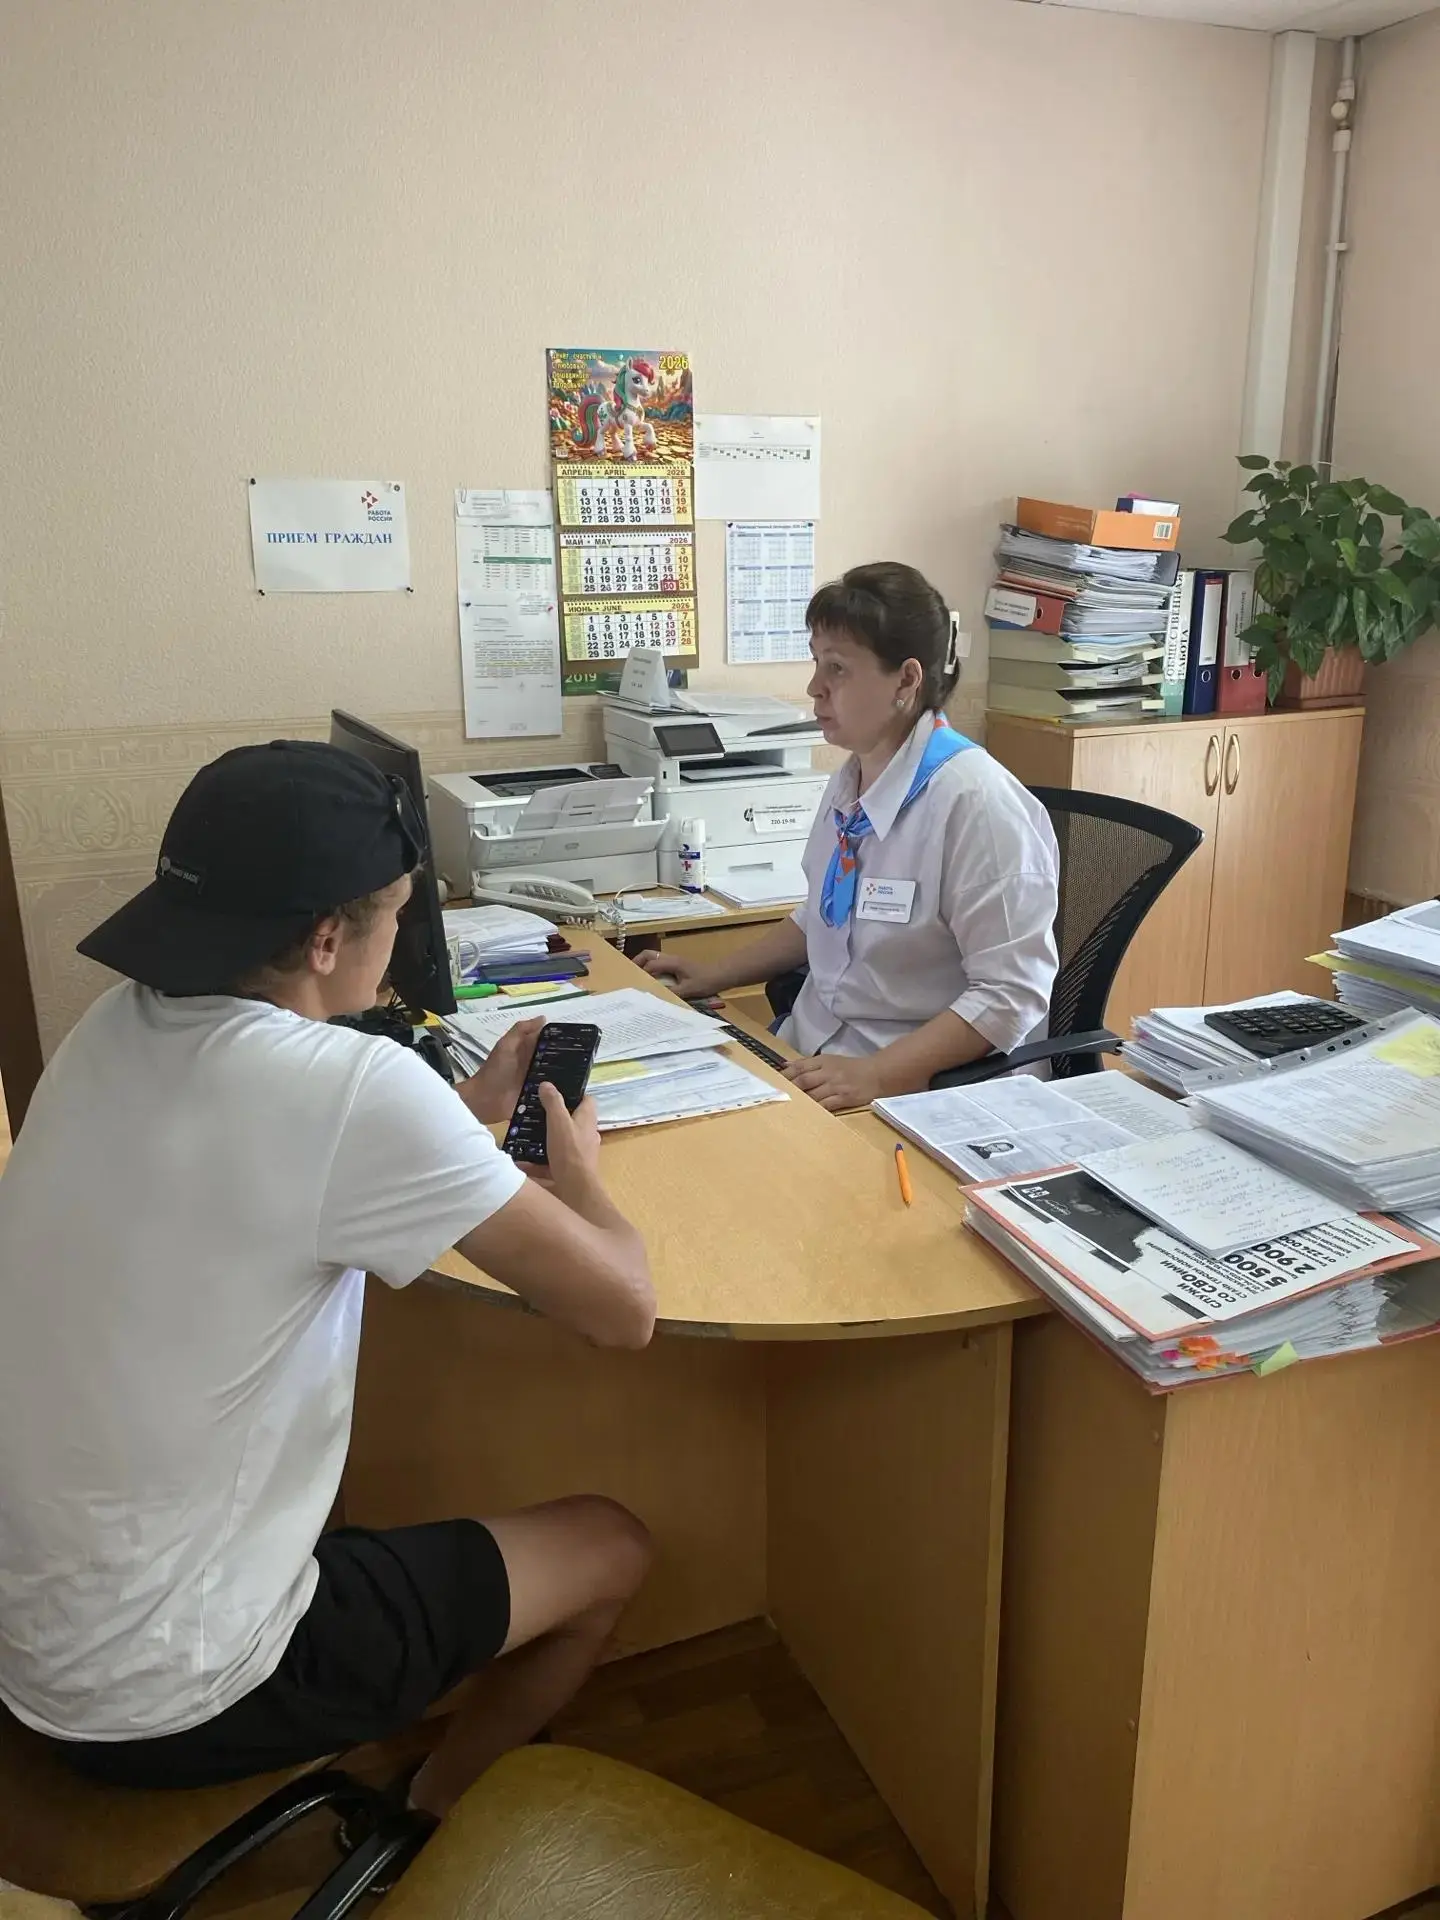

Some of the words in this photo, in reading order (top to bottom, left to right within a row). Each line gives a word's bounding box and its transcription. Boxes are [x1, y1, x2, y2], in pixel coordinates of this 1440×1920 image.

[658, 355, 689, 370] 2026
[646, 479, 652, 487] 3
[266, 532, 318, 544] ПРИЕМ
[325, 533, 392, 545] ГРАЖДАН
[615, 566, 625, 574] 13
[1166, 574, 1183, 676] ОБЩЕСТВЕННАЯ
[1178, 629, 1188, 676] РАБОТА
[1251, 1243, 1299, 1265] 900
[1223, 1254, 1270, 1278] 500
[1294, 1264, 1316, 1274] 2
[1192, 1268, 1222, 1284] ГЕРОЕМ
[1265, 1277, 1287, 1287] 5
[1177, 1283, 1221, 1308] СЛУЖИ
[1222, 1284, 1247, 1298] СТАНЬ
